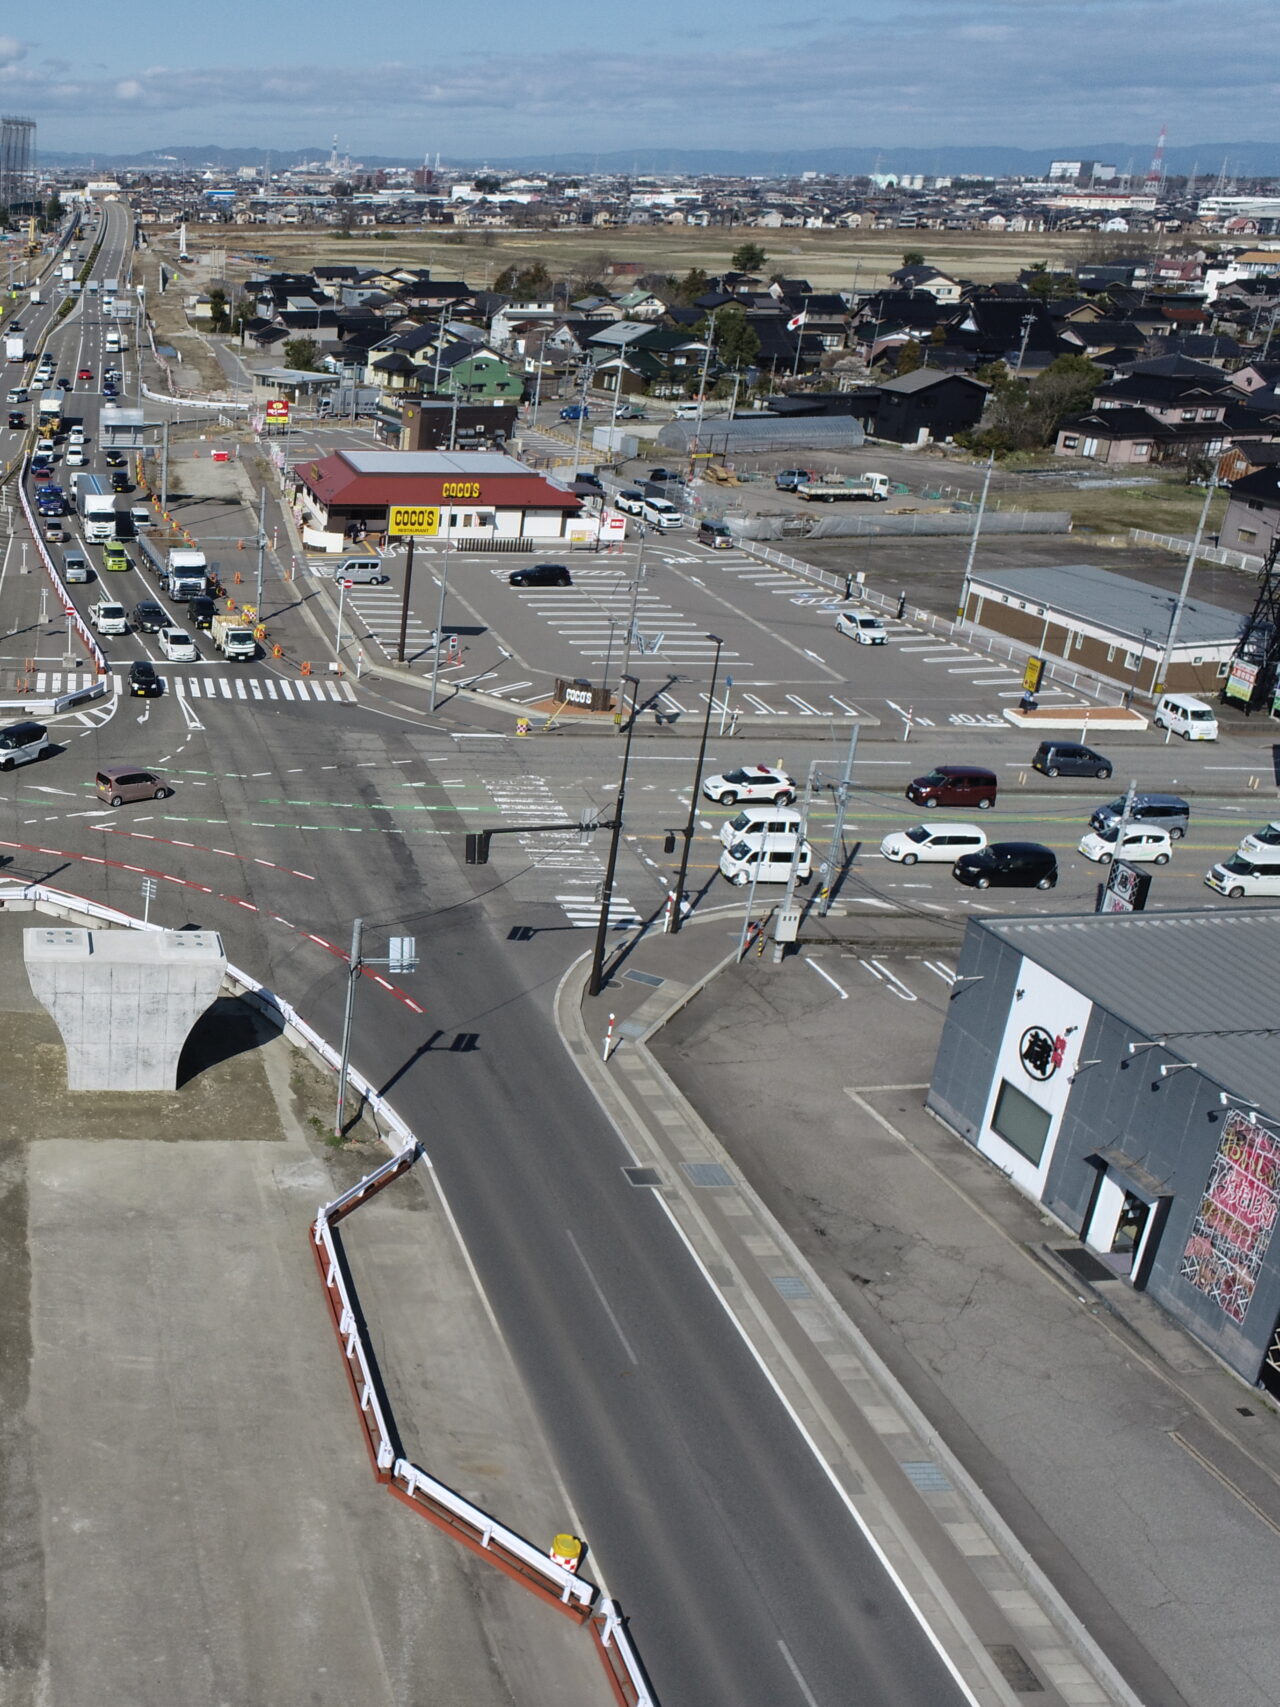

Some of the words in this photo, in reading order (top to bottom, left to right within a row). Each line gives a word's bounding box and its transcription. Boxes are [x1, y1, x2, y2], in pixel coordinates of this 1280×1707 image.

[442, 482, 480, 498] COCO'S
[394, 509, 434, 527] COCO'S
[565, 688, 592, 704] COCO'S
[948, 713, 1005, 724] STOP
